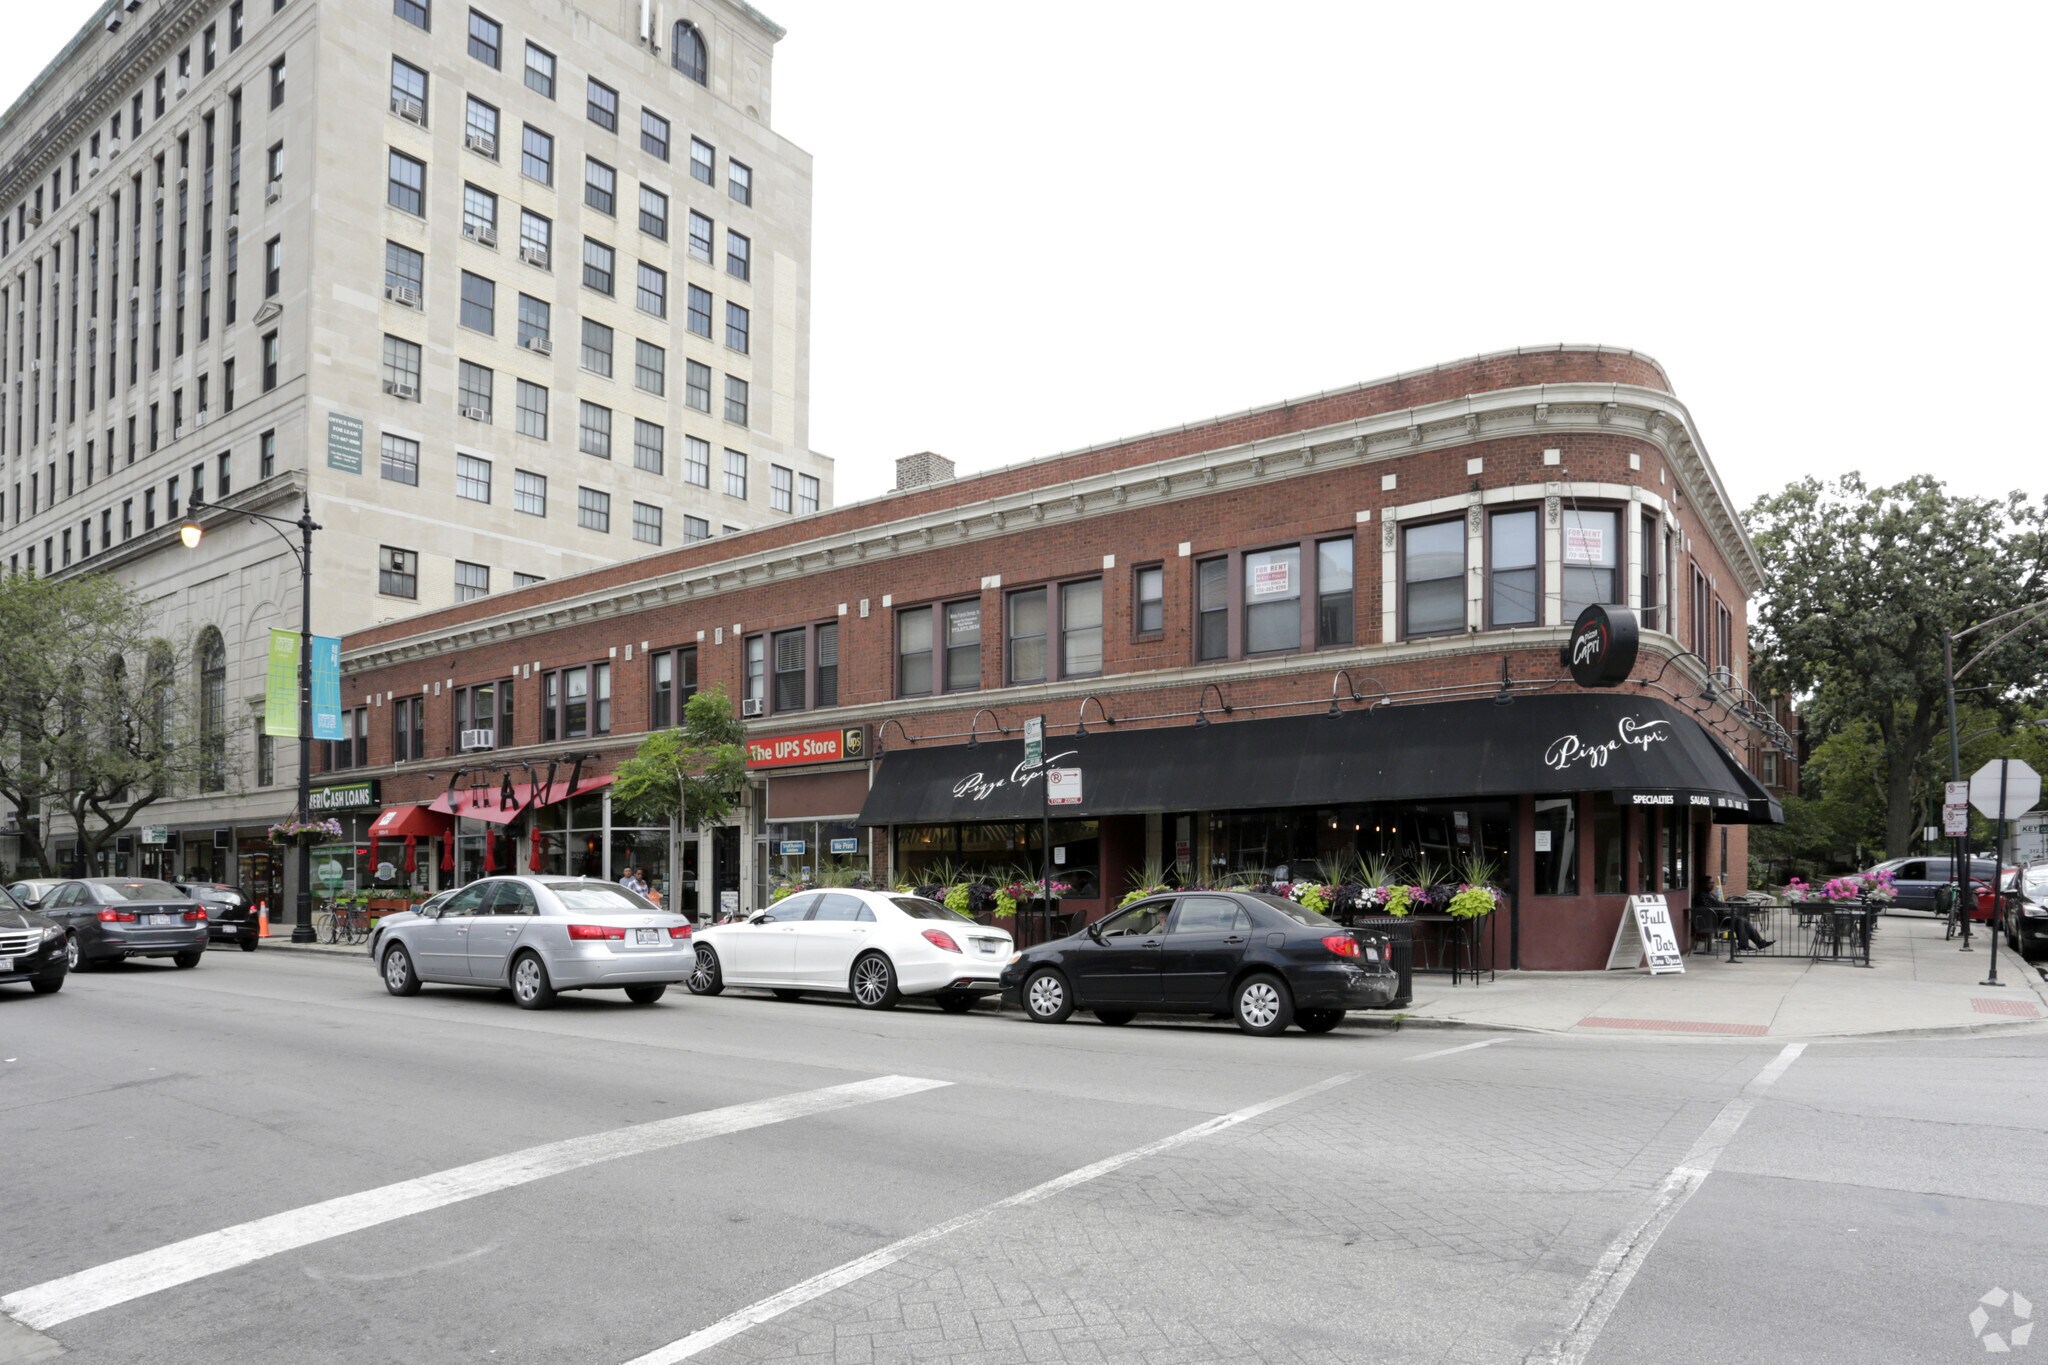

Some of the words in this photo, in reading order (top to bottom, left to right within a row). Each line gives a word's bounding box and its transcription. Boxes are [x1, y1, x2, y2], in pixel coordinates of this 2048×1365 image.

[328, 416, 348, 427] OFFICE
[347, 420, 362, 430] SPACE
[332, 426, 343, 434] FOR
[343, 428, 359, 437] LEASE
[1568, 529, 1581, 537] FOR
[1583, 530, 1601, 538] RENT
[1255, 566, 1269, 574] FOR
[1270, 563, 1287, 571] RENT
[1573, 634, 1600, 665] Capri
[750, 744, 773, 761] The
[775, 740, 800, 759] UPS
[803, 738, 837, 756] Store
[847, 734, 862, 751] ups
[1544, 734, 1622, 771] Pizza
[1618, 715, 1671, 752] Capri
[952, 772, 1008, 801] Pizza
[344, 788, 370, 807] LOANS
[1632, 794, 1675, 805] SPECIALTIES
[1689, 795, 1710, 806] SALADS
[842, 841, 854, 850] Print
[1639, 909, 1666, 925] Full
[1652, 933, 1676, 951] Bar
